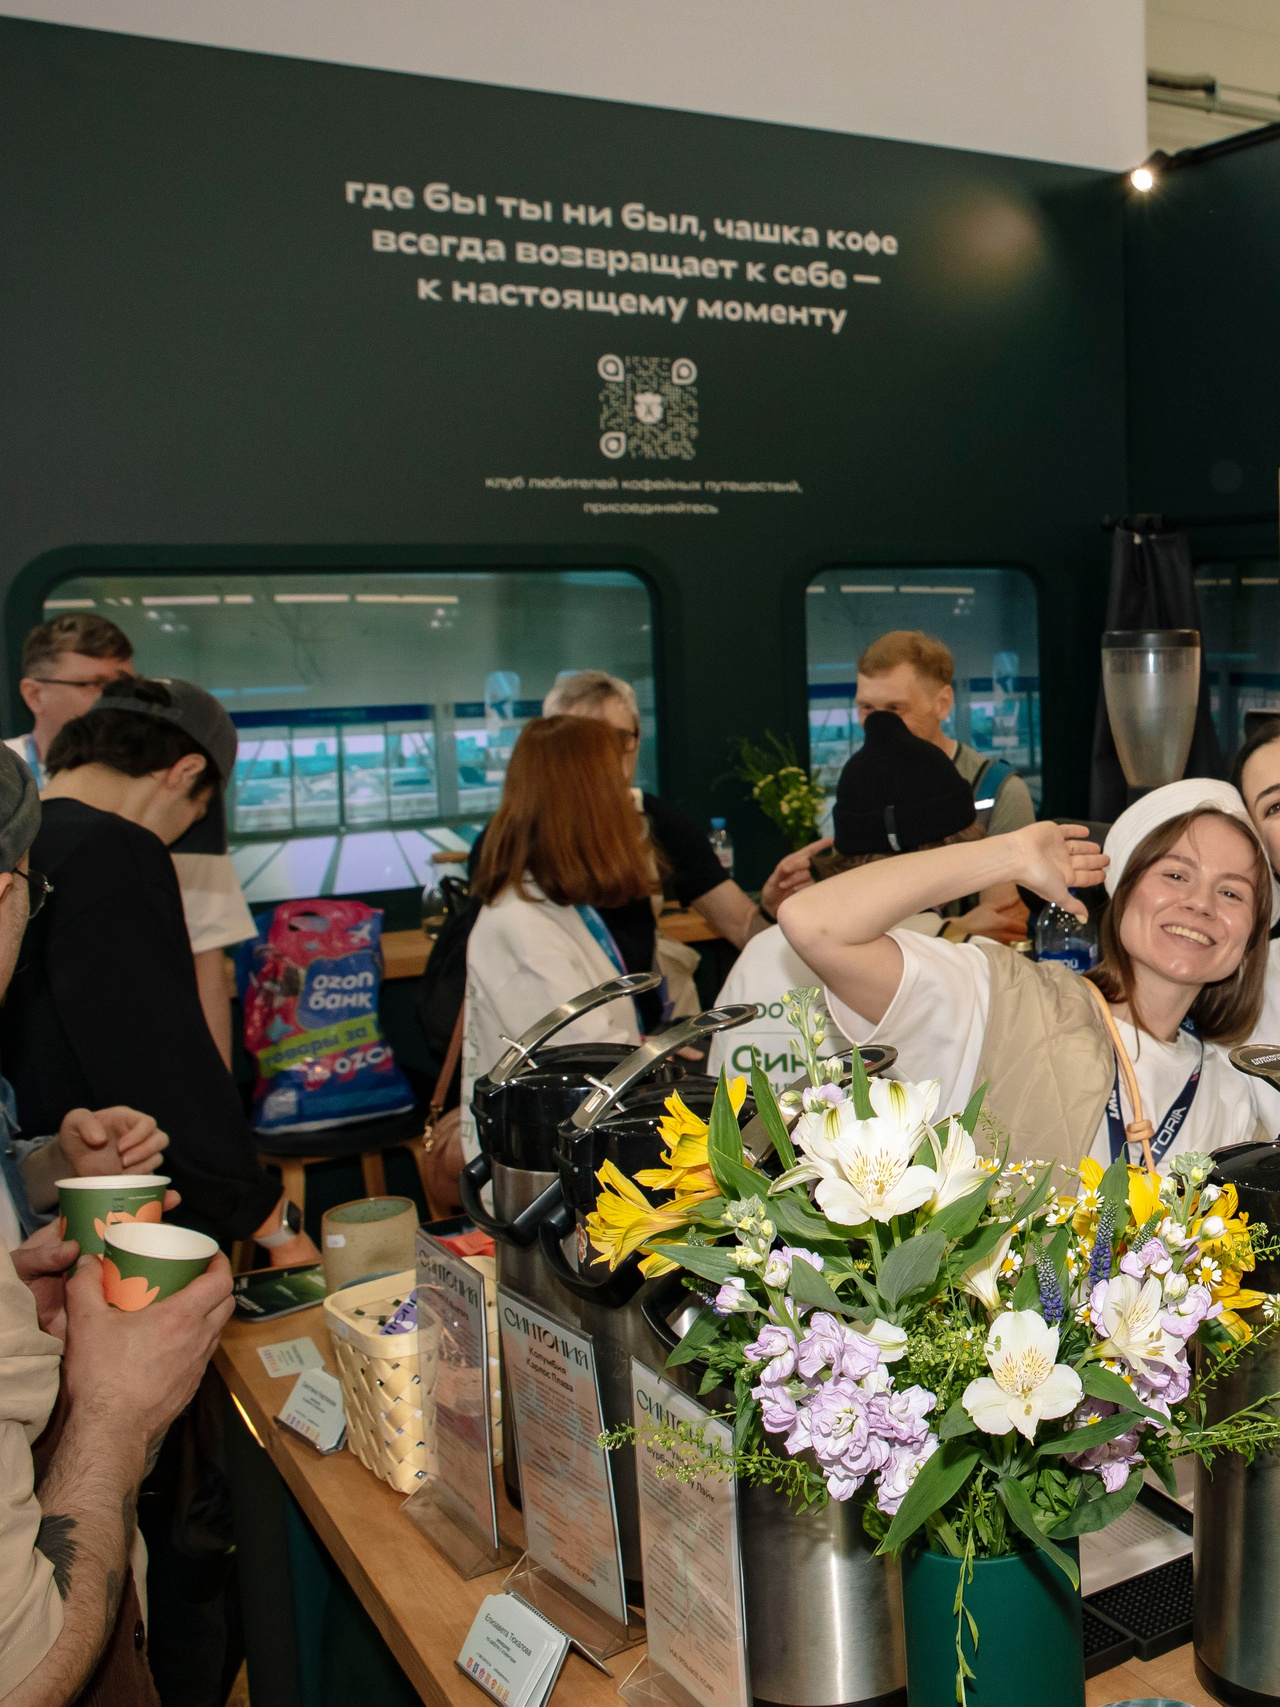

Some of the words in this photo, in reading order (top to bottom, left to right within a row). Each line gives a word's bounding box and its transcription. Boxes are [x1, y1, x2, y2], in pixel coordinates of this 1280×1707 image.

[346, 182, 414, 210] где
[424, 183, 486, 215] бы
[496, 197, 552, 221] ты
[563, 204, 612, 227] ни
[622, 203, 706, 241] был,
[714, 218, 819, 247] чашка
[827, 230, 898, 255] кофе
[373, 230, 505, 263] всегда
[516, 242, 738, 279] возвращает
[747, 262, 765, 282] к
[774, 261, 846, 289] себе
[418, 279, 441, 300] к
[452, 281, 687, 323] настоящему
[697, 299, 847, 333] моменту
[485, 475, 523, 490] клуб
[529, 476, 618, 491] любителей
[621, 478, 701, 494] кофейных
[583, 500, 718, 516] присоединяйтесь
[308, 991, 372, 1010] банк
[528, 1345, 566, 1376] Колумбия
